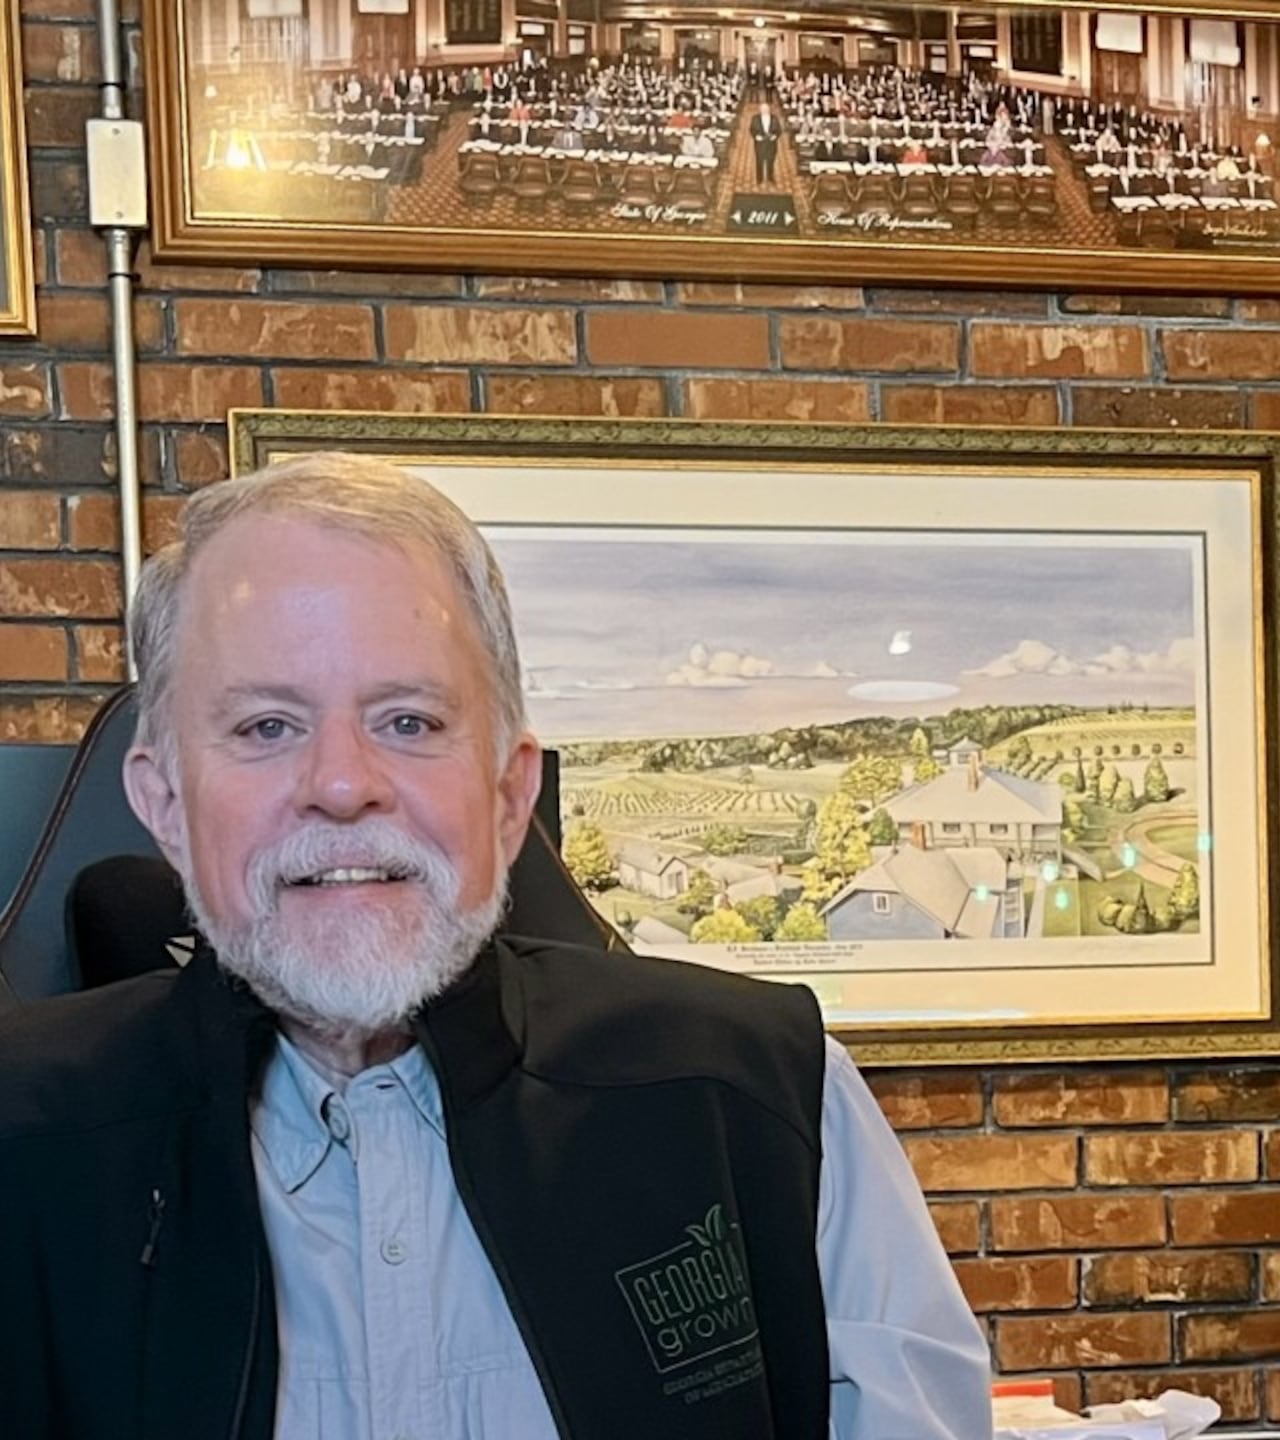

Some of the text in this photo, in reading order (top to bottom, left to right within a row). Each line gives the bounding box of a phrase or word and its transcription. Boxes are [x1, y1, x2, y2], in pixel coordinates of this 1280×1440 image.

[747, 210, 779, 225] 2011
[634, 1243, 749, 1325] GEORGIA
[658, 1297, 751, 1357] grown
